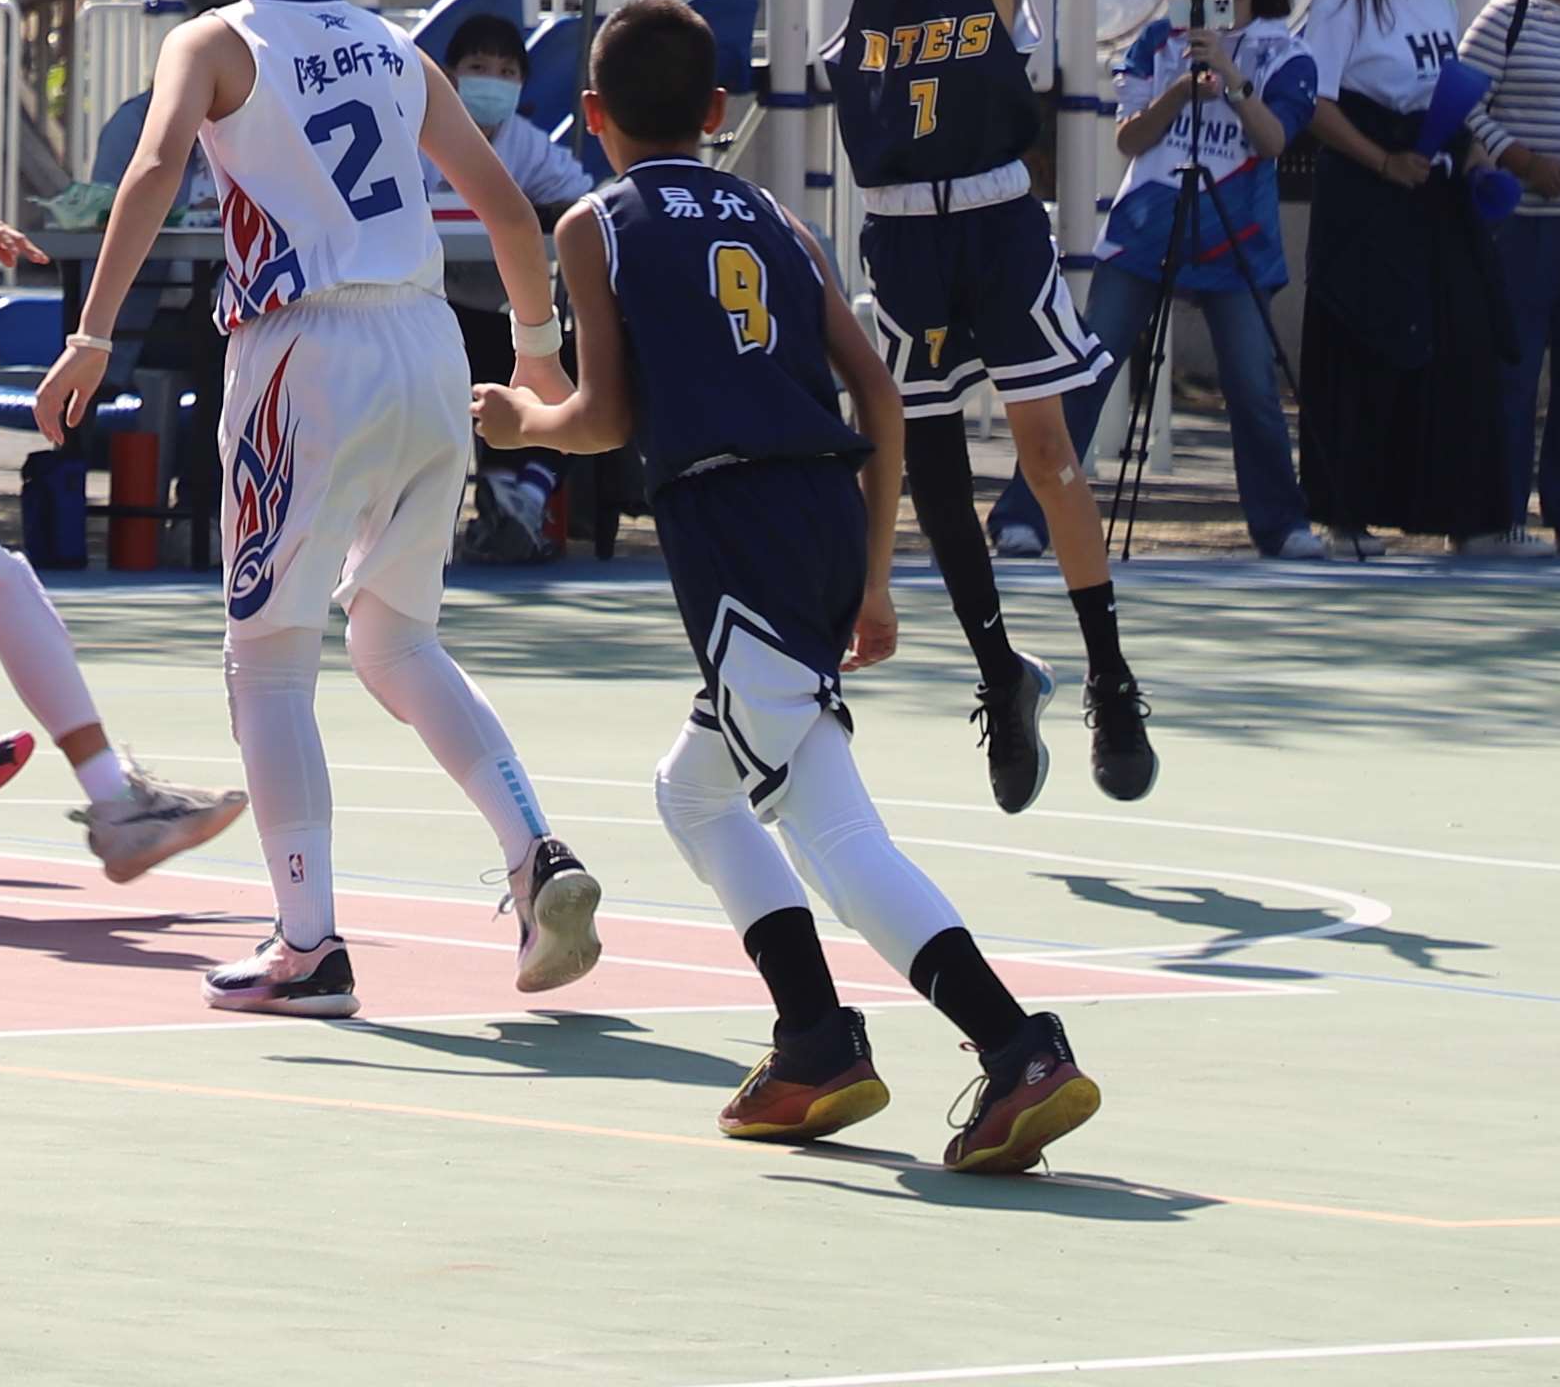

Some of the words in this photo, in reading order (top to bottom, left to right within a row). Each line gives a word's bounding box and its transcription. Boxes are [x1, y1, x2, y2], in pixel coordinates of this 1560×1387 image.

[859, 11, 996, 73] DTES
[909, 77, 940, 140] 7
[303, 99, 430, 222] 2
[708, 240, 778, 355] 9
[925, 325, 948, 368] 7
